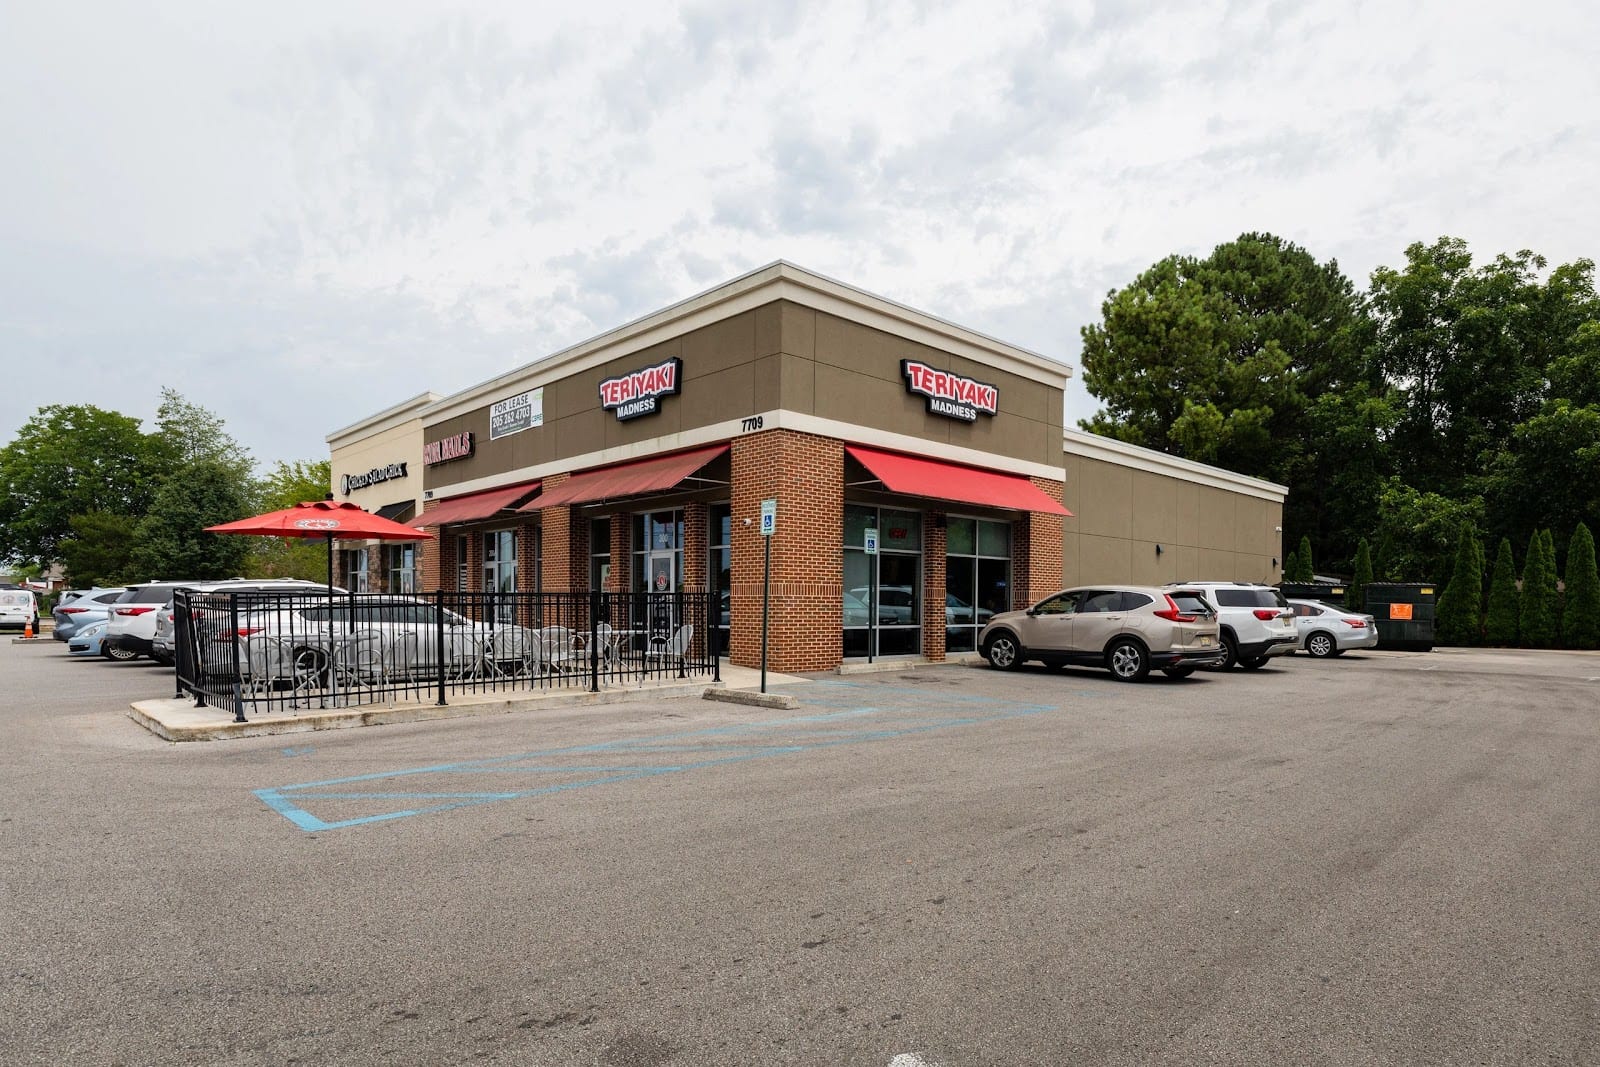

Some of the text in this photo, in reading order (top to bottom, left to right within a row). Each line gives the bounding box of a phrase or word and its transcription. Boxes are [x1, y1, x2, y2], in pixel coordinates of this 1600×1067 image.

[601, 363, 676, 406] TERIYAKI
[907, 363, 997, 412] TERIYAKI
[494, 402, 507, 415] FOR
[509, 394, 529, 409] LEASE
[617, 397, 655, 418] MADNESS
[931, 399, 977, 420] MADNESS
[492, 415, 503, 428] 205
[741, 415, 763, 433] 7709
